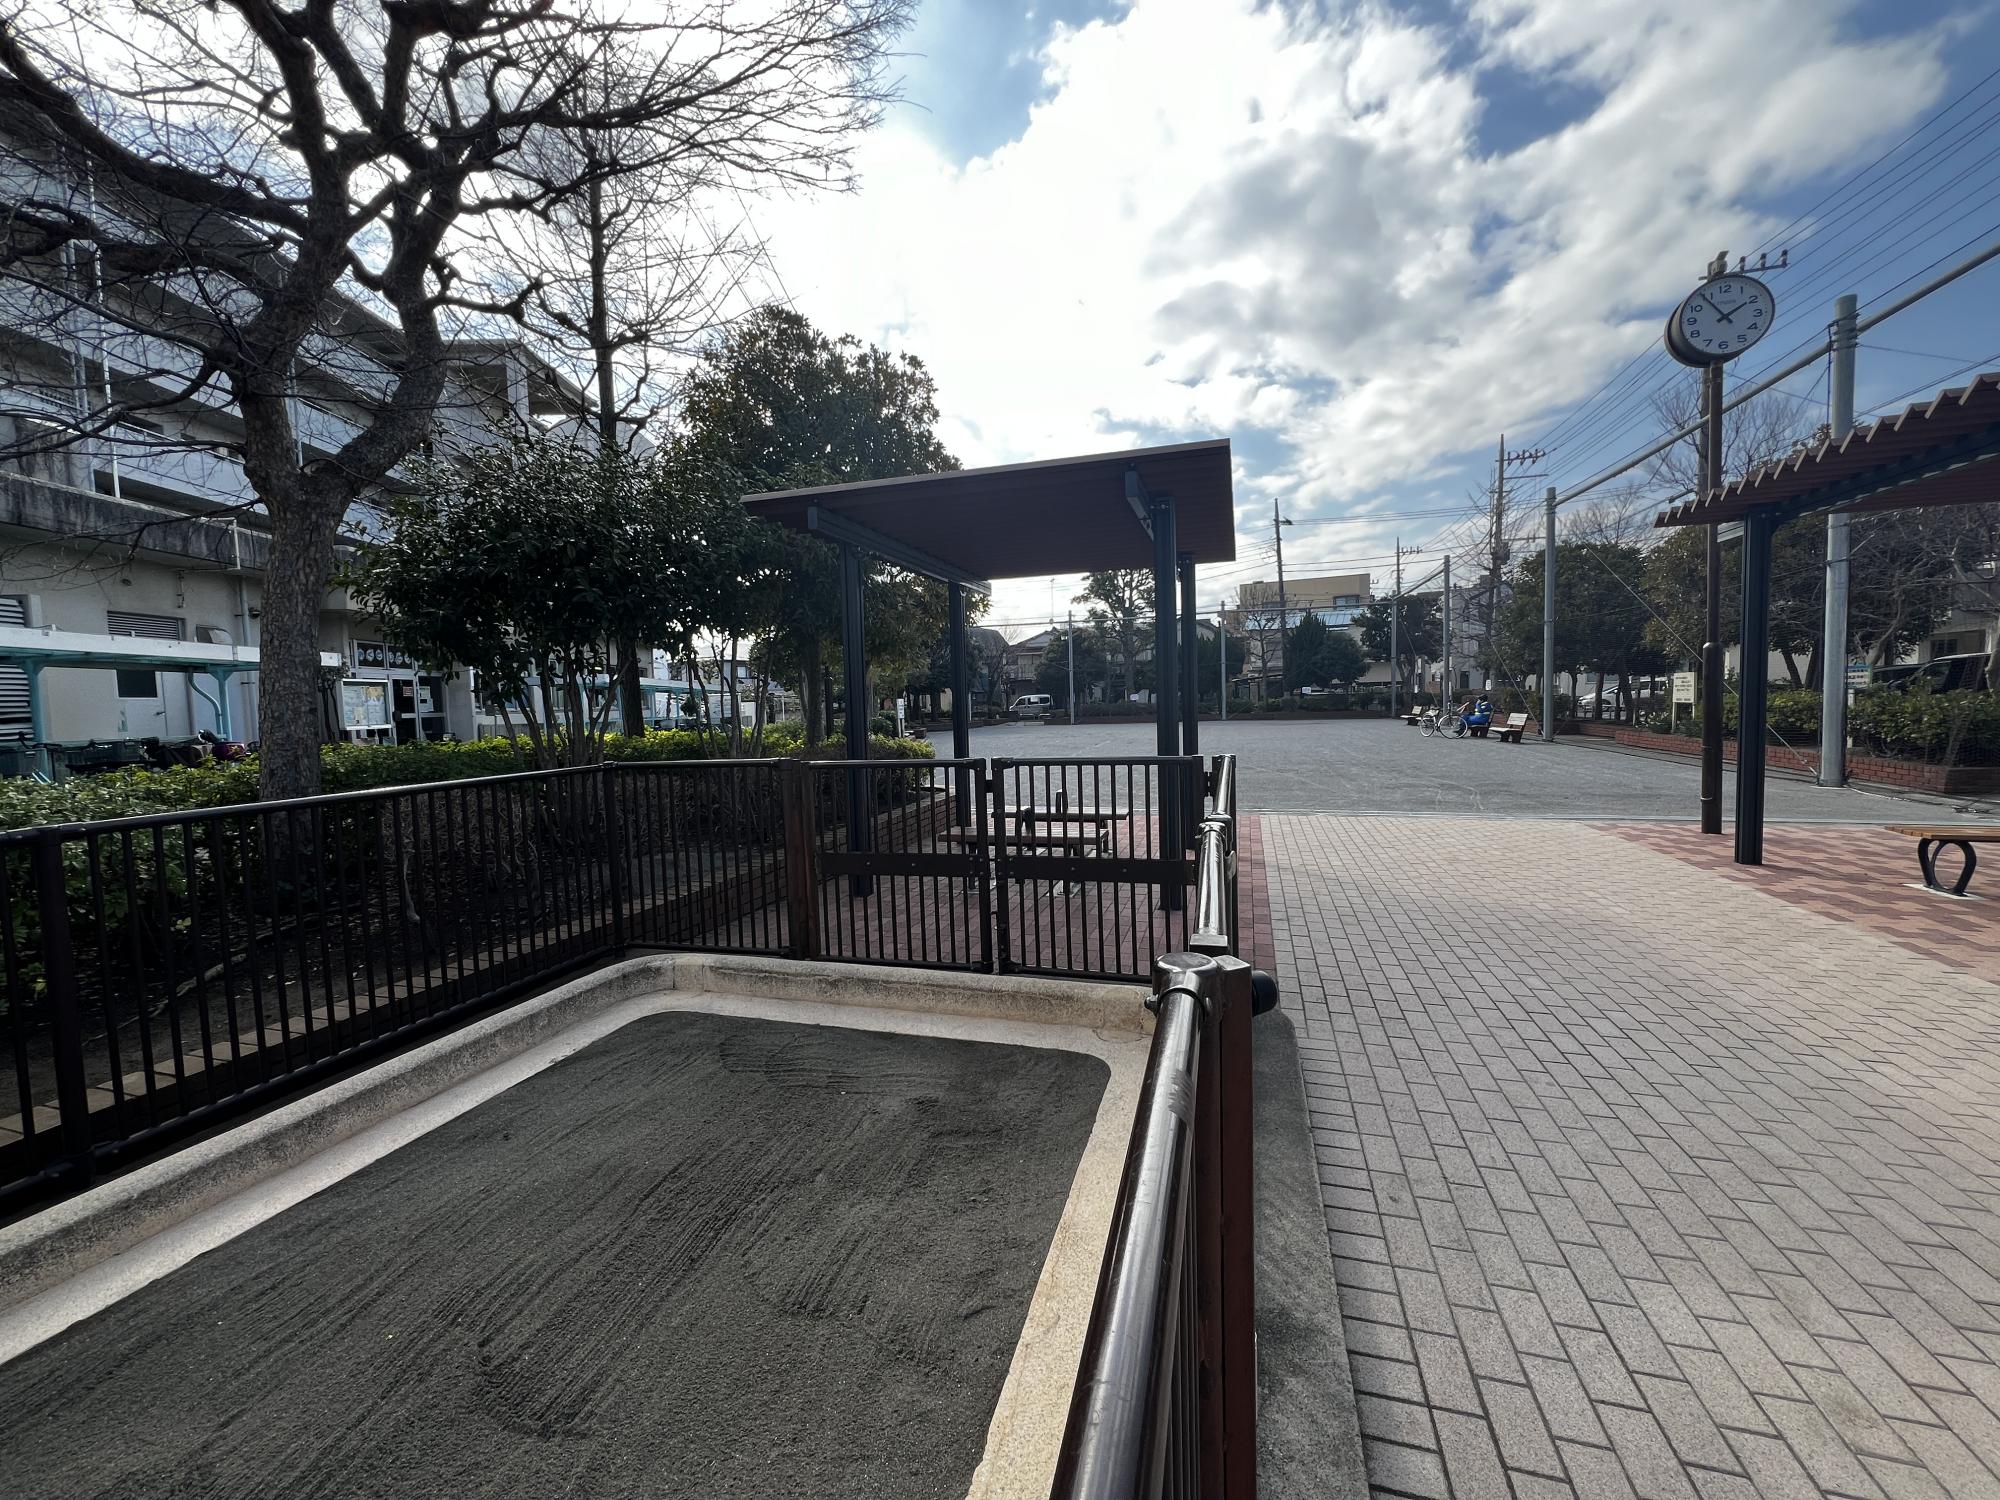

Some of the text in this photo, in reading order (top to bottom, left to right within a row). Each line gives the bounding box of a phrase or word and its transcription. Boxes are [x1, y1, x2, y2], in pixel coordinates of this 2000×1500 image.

[1719, 284, 1732, 294] 12
[1740, 286, 1744, 295] 1
[1748, 295, 1758, 305] 2
[1690, 304, 1703, 313] 10
[1752, 308, 1763, 318] 3
[1687, 317, 1697, 326] 9
[1747, 322, 1759, 331] 4
[1690, 330, 1700, 339] 8
[1737, 334, 1748, 343] 5
[1703, 338, 1713, 348] 7
[1718, 341, 1729, 350] 6
